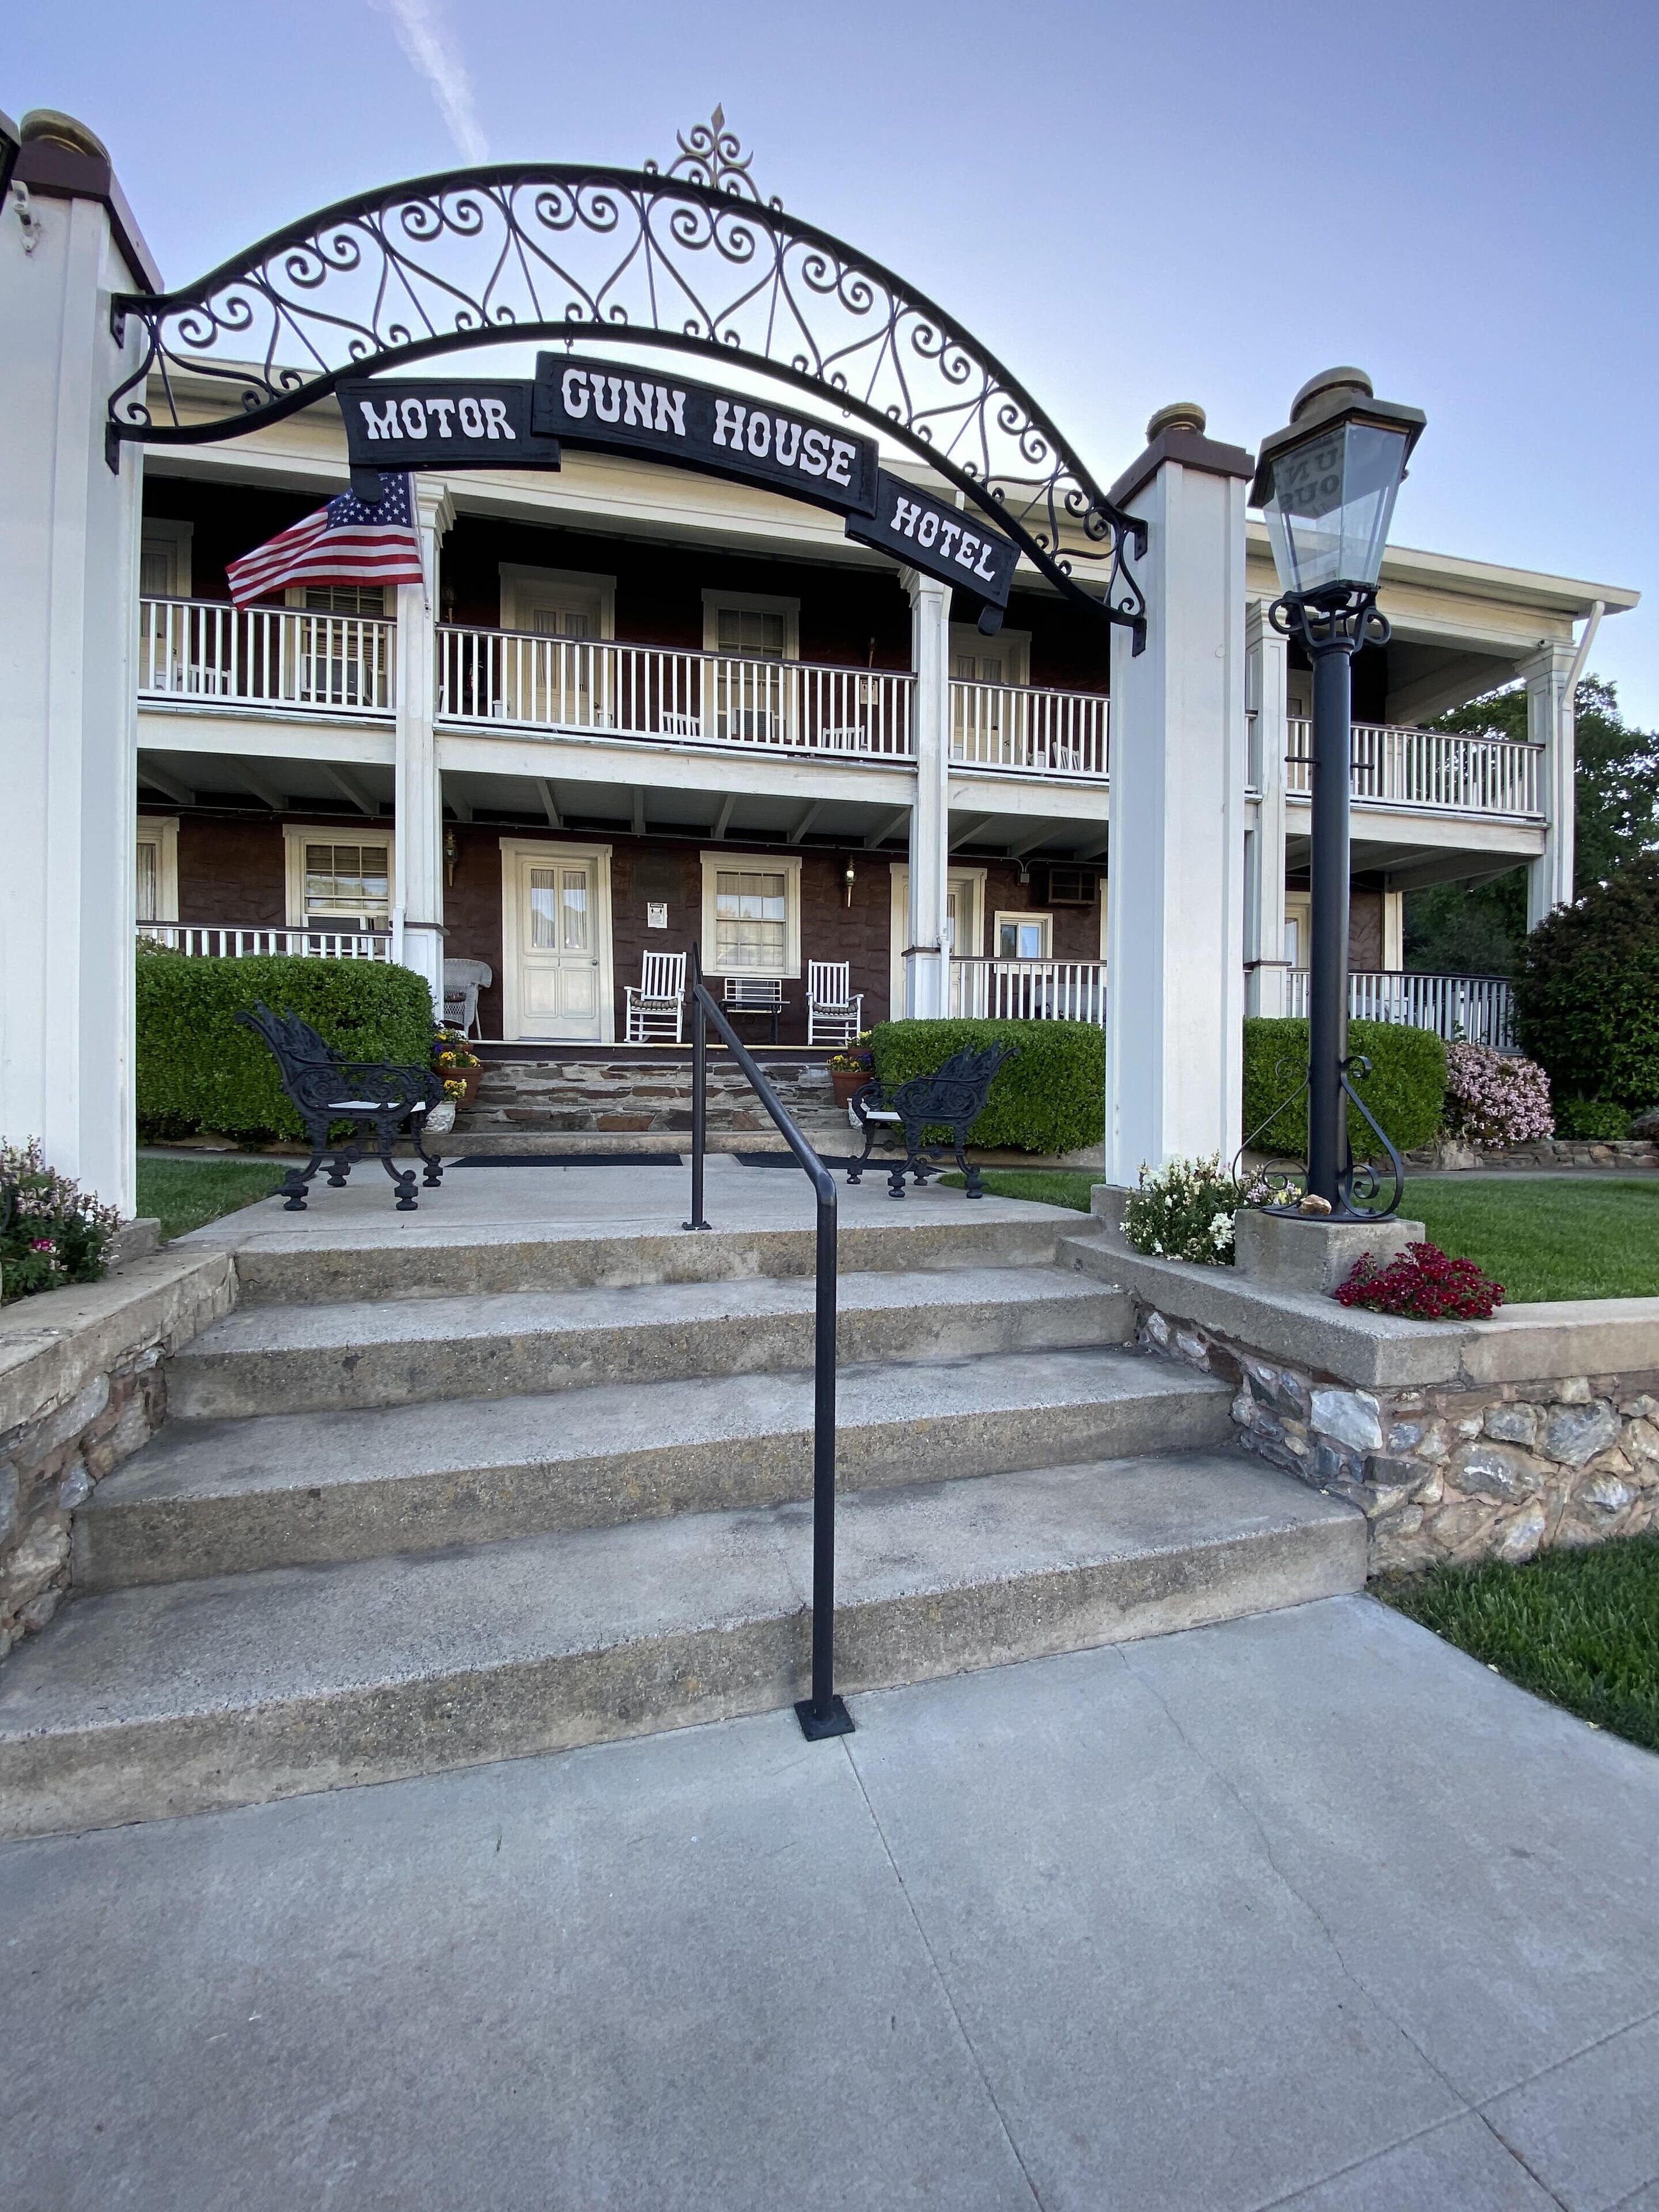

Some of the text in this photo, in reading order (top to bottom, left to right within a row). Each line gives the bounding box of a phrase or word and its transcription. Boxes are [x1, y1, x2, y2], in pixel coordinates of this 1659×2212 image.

[360, 398, 516, 440] MOTOR
[562, 369, 856, 487] GUNN HOUSE
[891, 497, 995, 582] HOTEL
